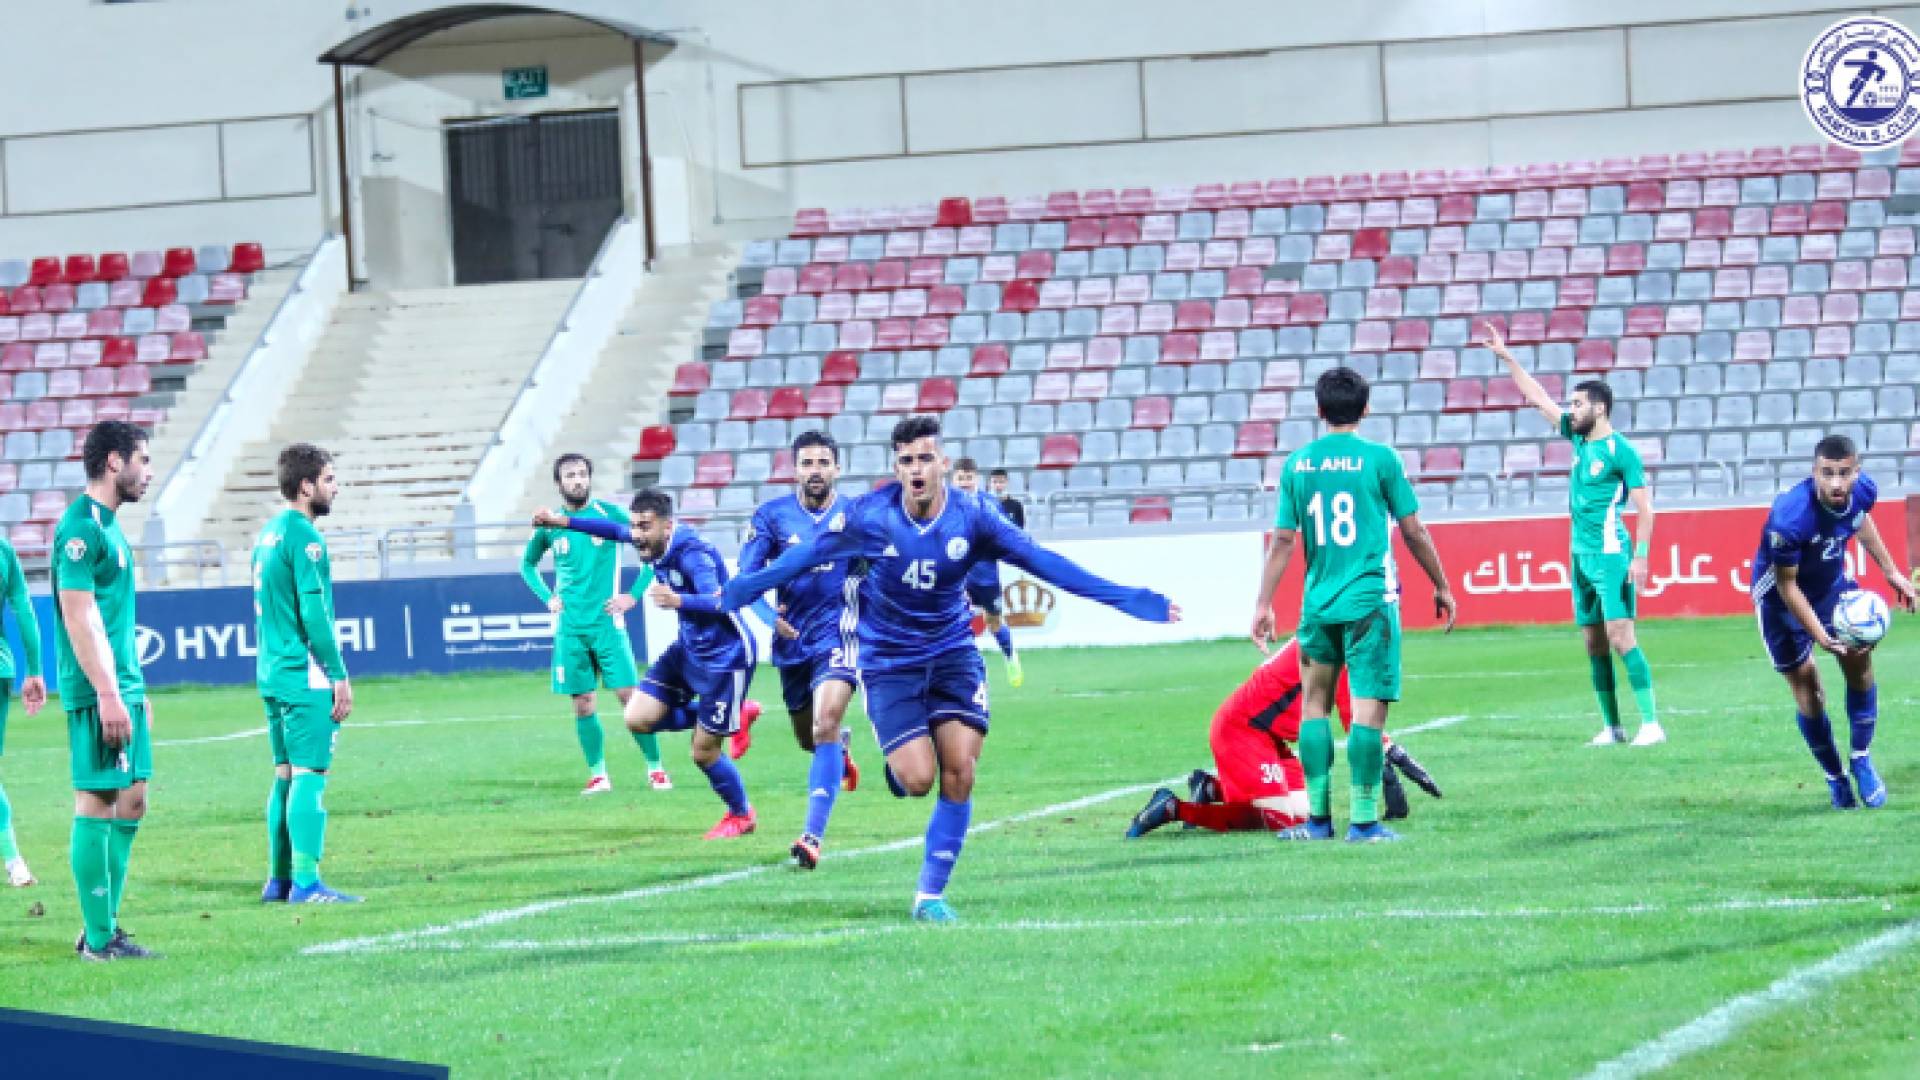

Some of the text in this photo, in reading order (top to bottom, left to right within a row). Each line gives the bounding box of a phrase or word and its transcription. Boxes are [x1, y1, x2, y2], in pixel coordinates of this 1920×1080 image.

[504, 69, 545, 87] EXIT
[1295, 456, 1364, 472] AL AHLI
[1307, 490, 1357, 546] 18
[901, 558, 937, 590] 45
[1462, 551, 1572, 595] حتك
[174, 616, 377, 661] HYUAI
[711, 700, 728, 725] 3
